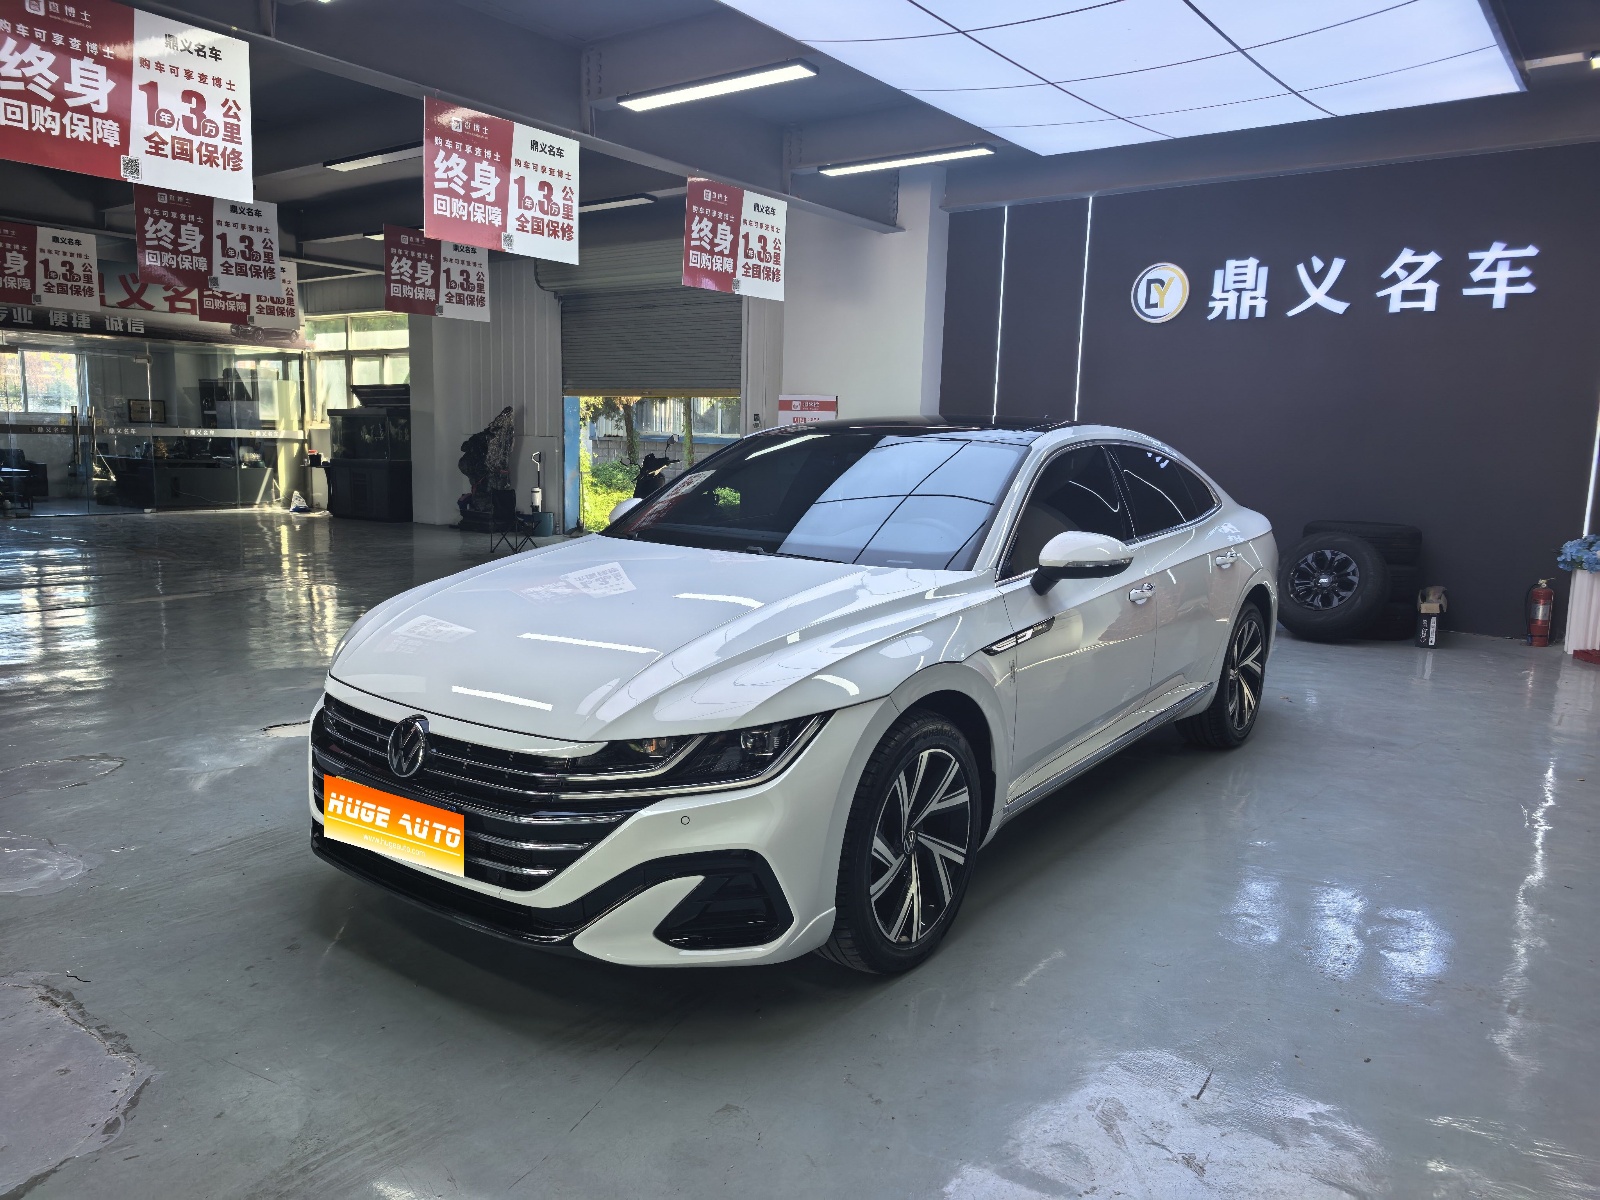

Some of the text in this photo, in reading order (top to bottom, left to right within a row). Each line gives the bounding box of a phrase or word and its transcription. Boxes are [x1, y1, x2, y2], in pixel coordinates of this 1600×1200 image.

[0, 18, 115, 60] 购车可享查博士
[164, 33, 223, 62] 鼎义名车
[0, 36, 117, 114] 终身
[139, 56, 236, 92] 购车可享查博士
[0, 97, 121, 148] 回购保障
[143, 130, 244, 172] 全国保修
[434, 135, 501, 162] 购车可享查博士
[530, 139, 565, 159] 鼎义名车
[433, 148, 502, 203] 终身
[514, 157, 572, 181] 购车可享查博士
[229, 204, 263, 218] 鼎义名车
[433, 193, 503, 228] 回购保障
[144, 216, 205, 254] 终身
[514, 212, 575, 242] 全国保修
[690, 214, 735, 255] 终身
[145, 249, 208, 272] 回购保障
[219, 260, 276, 281] 全国保修
[390, 255, 435, 286] 终身
[689, 249, 734, 274] 回购保障
[741, 261, 782, 283] 全国保修
[43, 281, 95, 298] 全国保修
[390, 282, 436, 302] 回购保障
[1206, 239, 1541, 321] 鼎义名车
[203, 297, 247, 312] 回购保障
[255, 303, 296, 318] 全国保修
[444, 291, 486, 308] 全国保修
[48, 309, 91, 330] 便捷
[104, 314, 145, 334] 诚信
